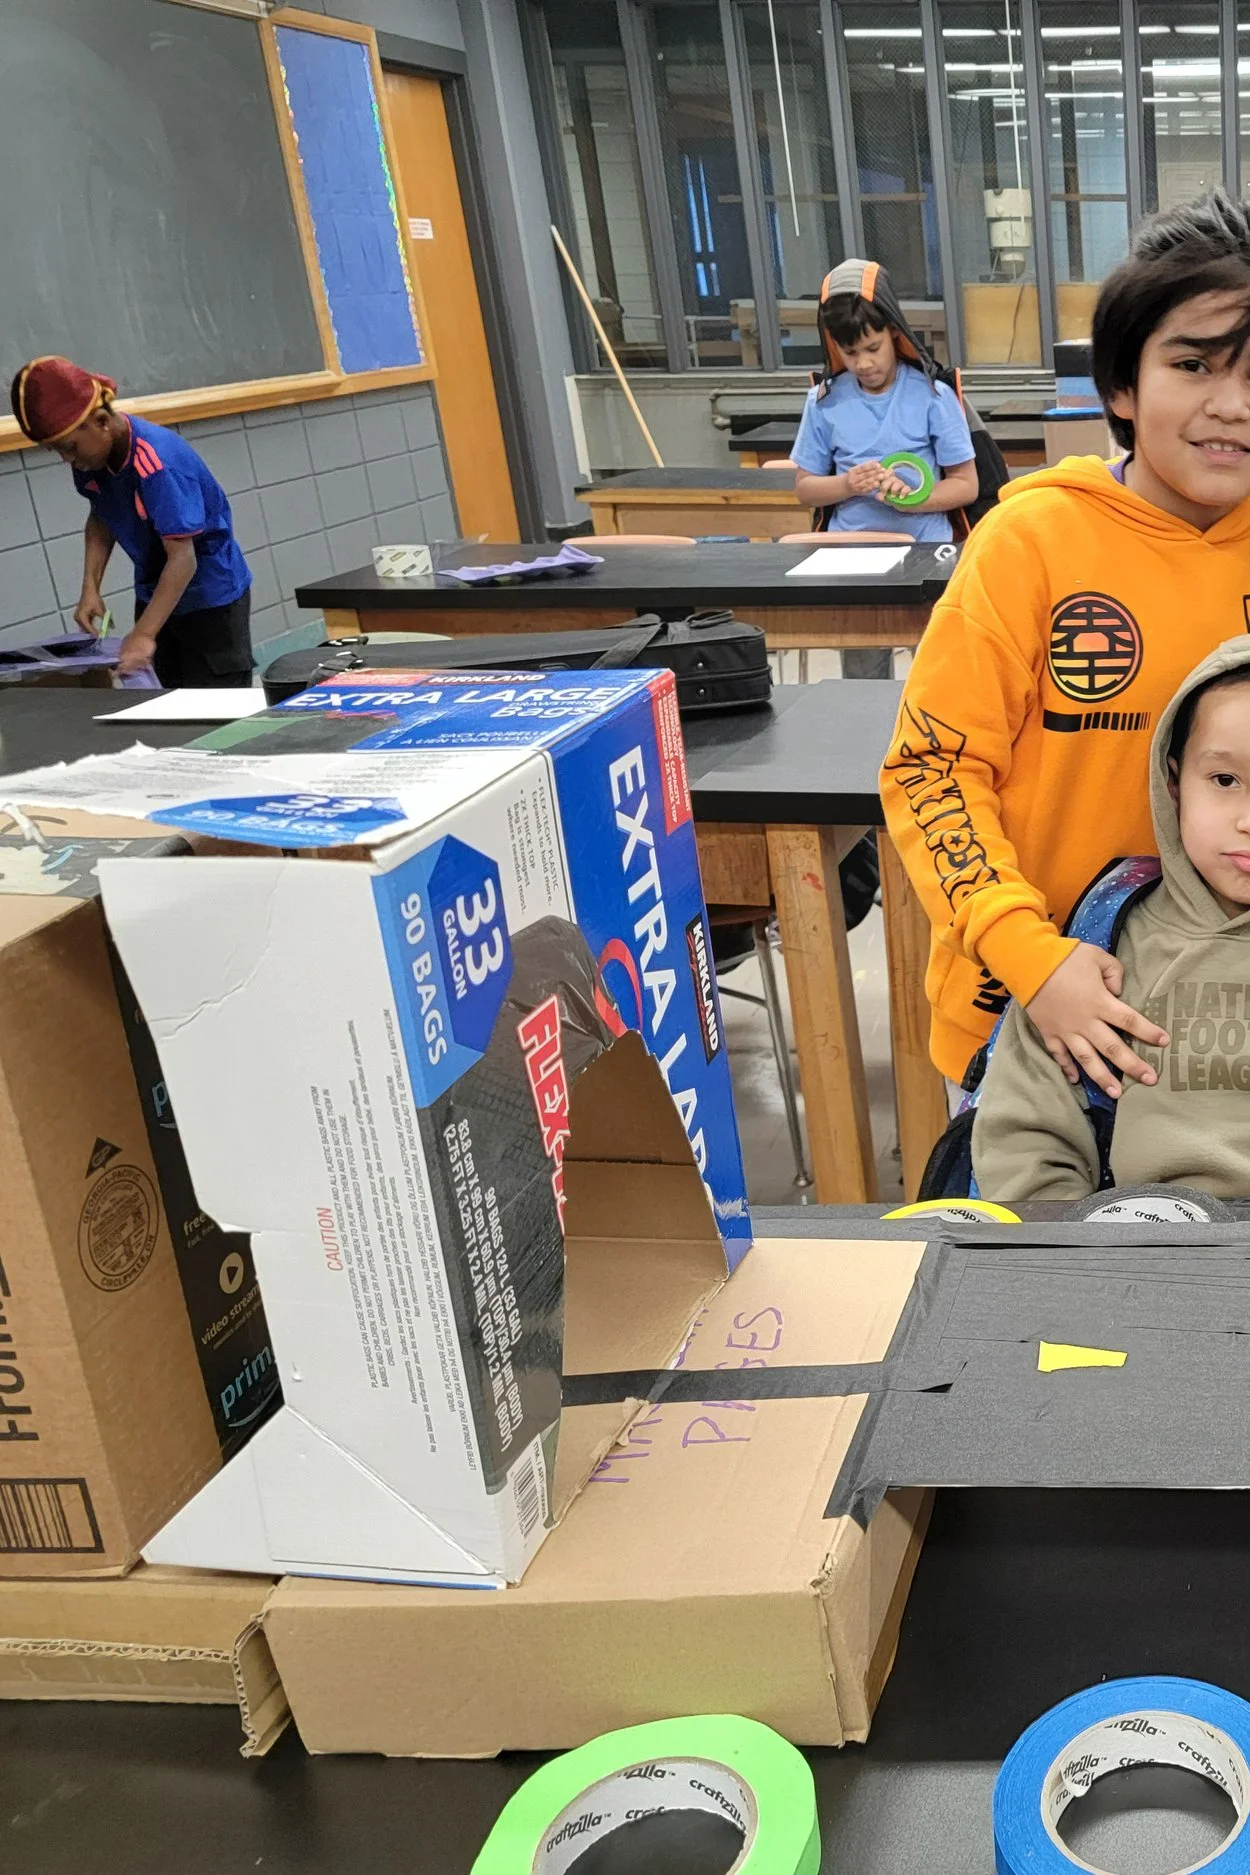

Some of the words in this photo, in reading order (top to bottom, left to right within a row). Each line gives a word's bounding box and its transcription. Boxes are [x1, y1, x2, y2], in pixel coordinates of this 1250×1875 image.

[428, 674, 546, 683] KIRKLAND
[283, 691, 443, 707] EXTRA
[453, 687, 622, 704] LARGE
[490, 706, 594, 719] Bags
[505, 806, 516, 840] where
[511, 802, 522, 824] Bag
[530, 790, 544, 835] Expands
[521, 814, 533, 847] THICK
[510, 843, 523, 882] needed
[516, 837, 531, 887] strongest
[526, 848, 536, 870] TOP
[539, 849, 549, 874] hold
[546, 848, 559, 891] PLASTIC
[516, 884, 528, 915] most.
[543, 875, 553, 907] more.
[608, 743, 678, 1038] EXTRA
[401, 892, 426, 945] 90
[456, 877, 504, 986] 33
[442, 909, 468, 1000] GALLON
[692, 920, 721, 1052] KIRKLAND
[412, 951, 448, 1066] BAGS
[310, 1085, 322, 1105] FROM
[315, 1106, 326, 1125] AWAY
[319, 1126, 330, 1144] BAGS
[442, 1123, 460, 1164] (2.75
[455, 1117, 472, 1152] 83.8
[322, 1146, 336, 1172] PLASTIC
[451, 1160, 464, 1183] FT
[462, 1151, 475, 1176] cm
[457, 1194, 473, 1230] 3.25
[469, 1186, 482, 1209] 99
[483, 1186, 496, 1208] 90
[334, 1202, 347, 1232] PRODUCT
[473, 1206, 485, 1232] cm
[486, 1206, 504, 1249] BAGS
[314, 1206, 343, 1270] CAUTION
[463, 1227, 477, 1250] FT
[469, 1259, 484, 1288] 2.4
[479, 1241, 495, 1274] 60.9
[494, 1246, 509, 1276] 124
[201, 1312, 229, 1345] video
[229, 1281, 261, 1320] stream
[473, 1283, 488, 1315] MIL
[500, 1285, 516, 1312] (33
[355, 1310, 367, 1330] CAUSE
[504, 1308, 523, 1346] GAL)
[221, 1345, 273, 1421] prim
[366, 1363, 378, 1387] PLASTIC
[491, 1372, 506, 1405] MIL
[504, 1382, 524, 1431] (BODY)
[493, 1400, 514, 1452] (BODY)
